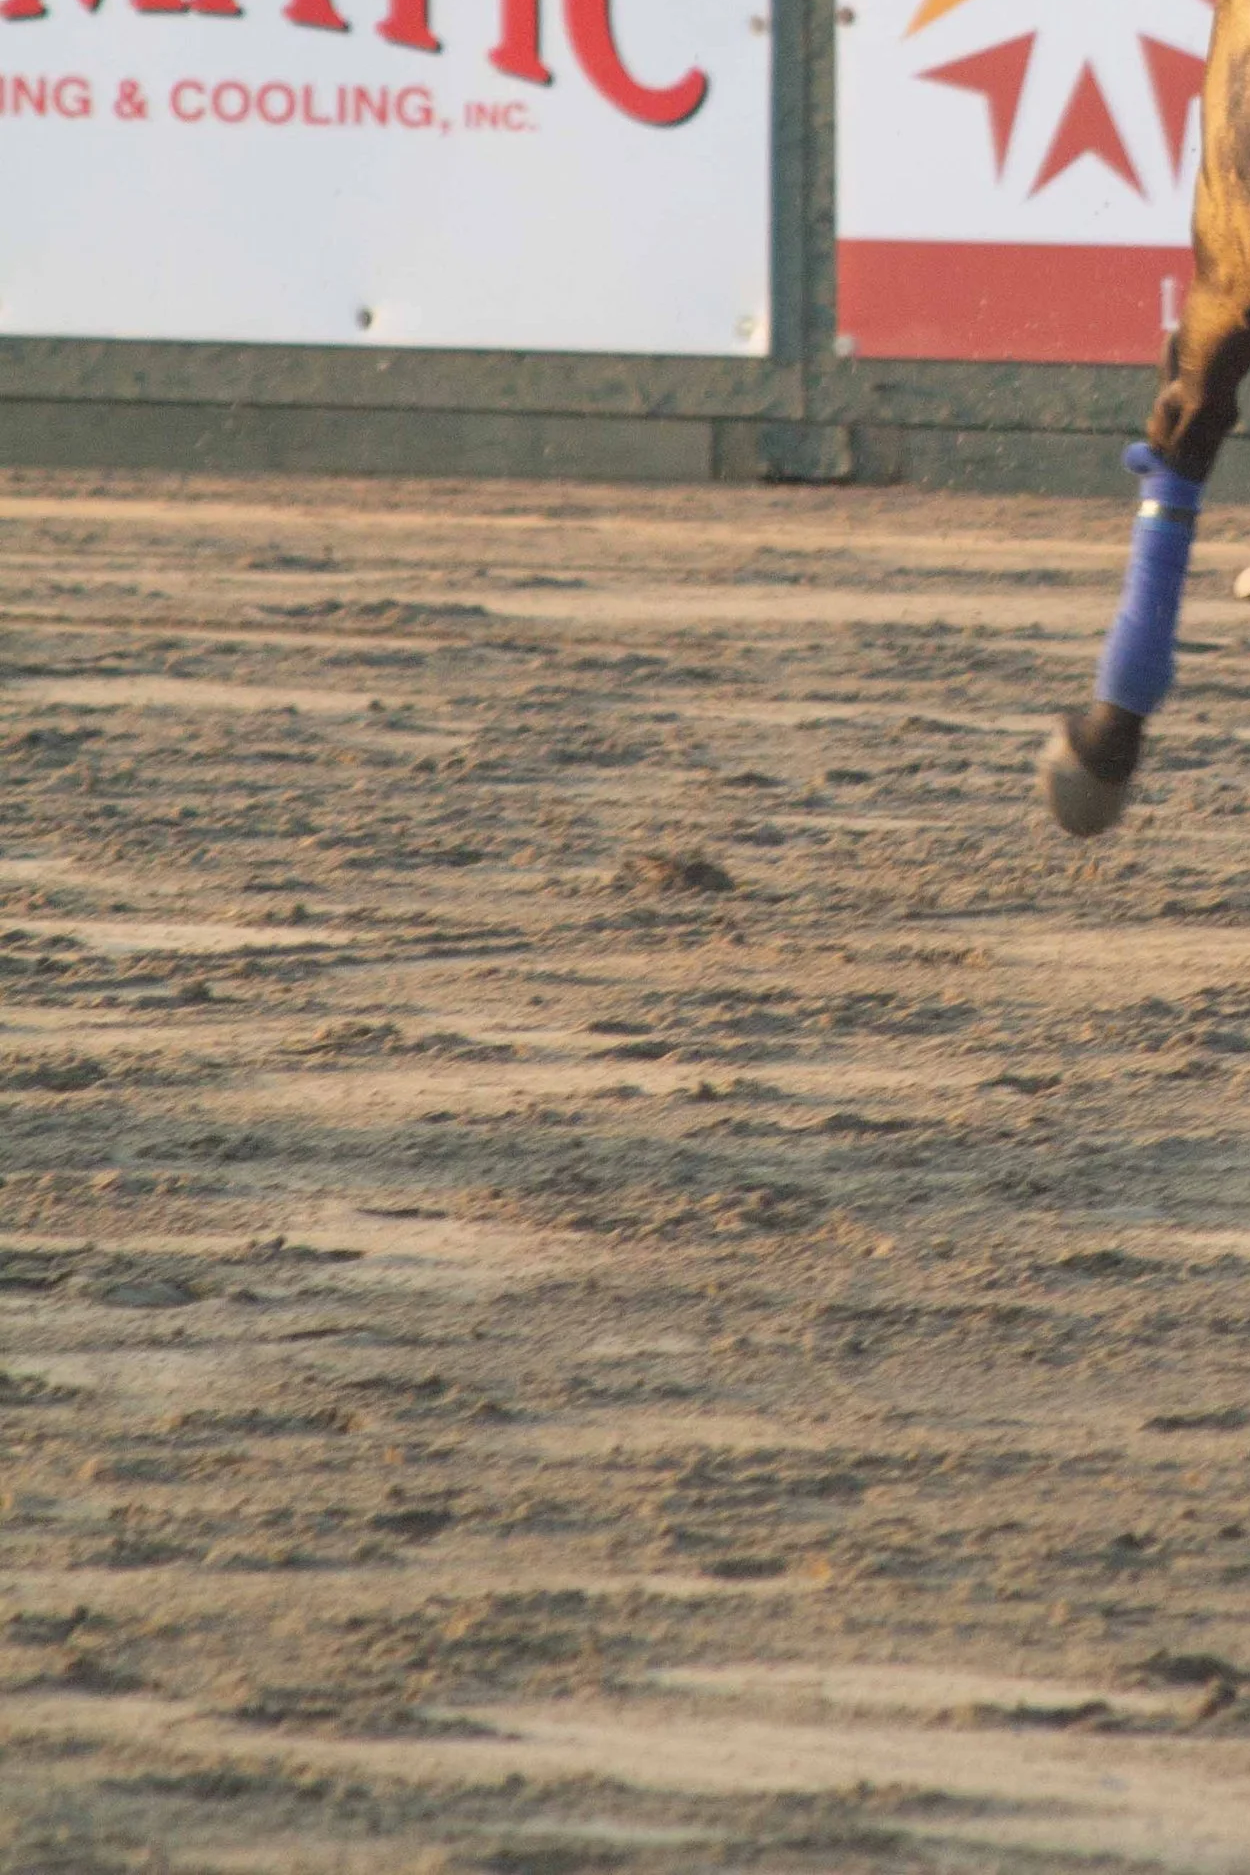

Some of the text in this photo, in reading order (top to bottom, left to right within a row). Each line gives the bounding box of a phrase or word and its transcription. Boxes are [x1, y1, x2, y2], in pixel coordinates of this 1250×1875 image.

[113, 78, 149, 121] &
[169, 78, 451, 136] COOLING,
[463, 100, 538, 133] INC.
